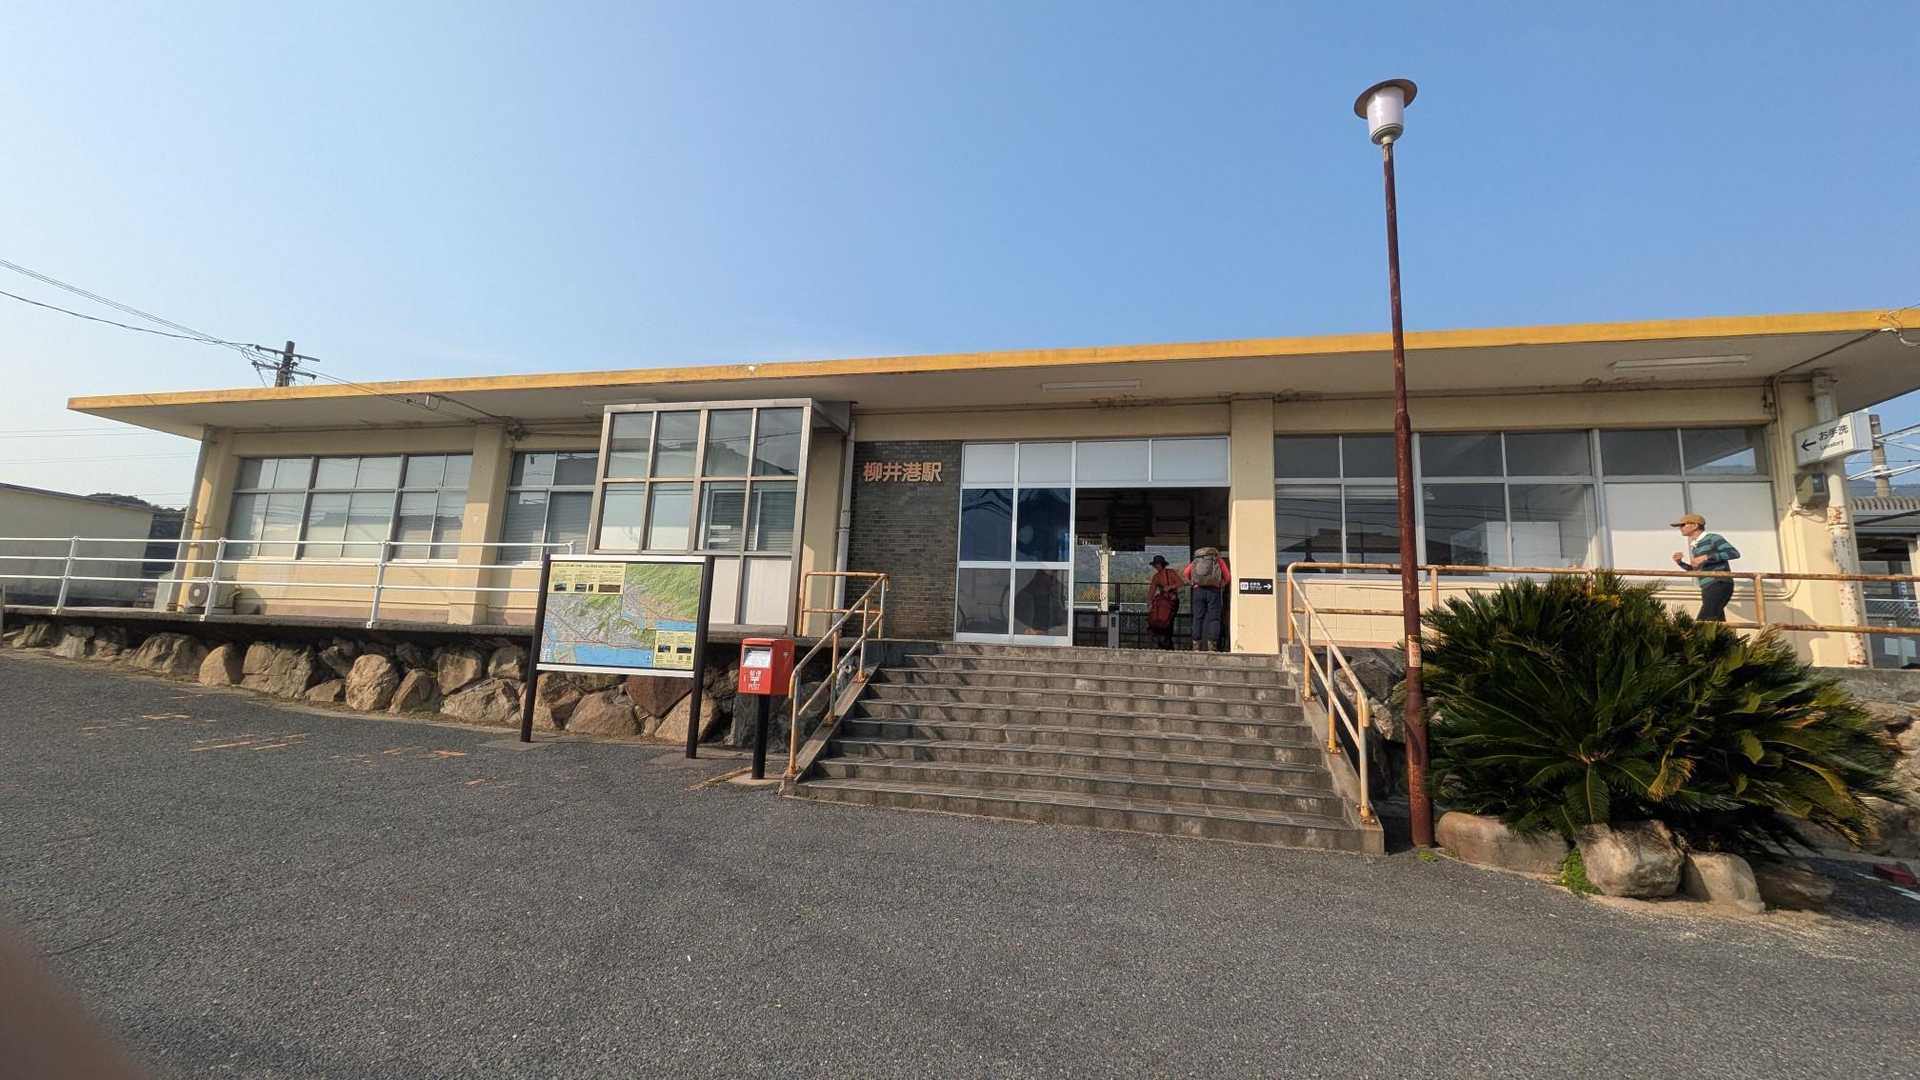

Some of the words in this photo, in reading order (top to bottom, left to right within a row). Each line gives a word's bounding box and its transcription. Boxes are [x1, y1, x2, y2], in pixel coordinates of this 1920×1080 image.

[1818, 424, 1848, 440] お手洗
[863, 461, 942, 482] 柳井港駅
